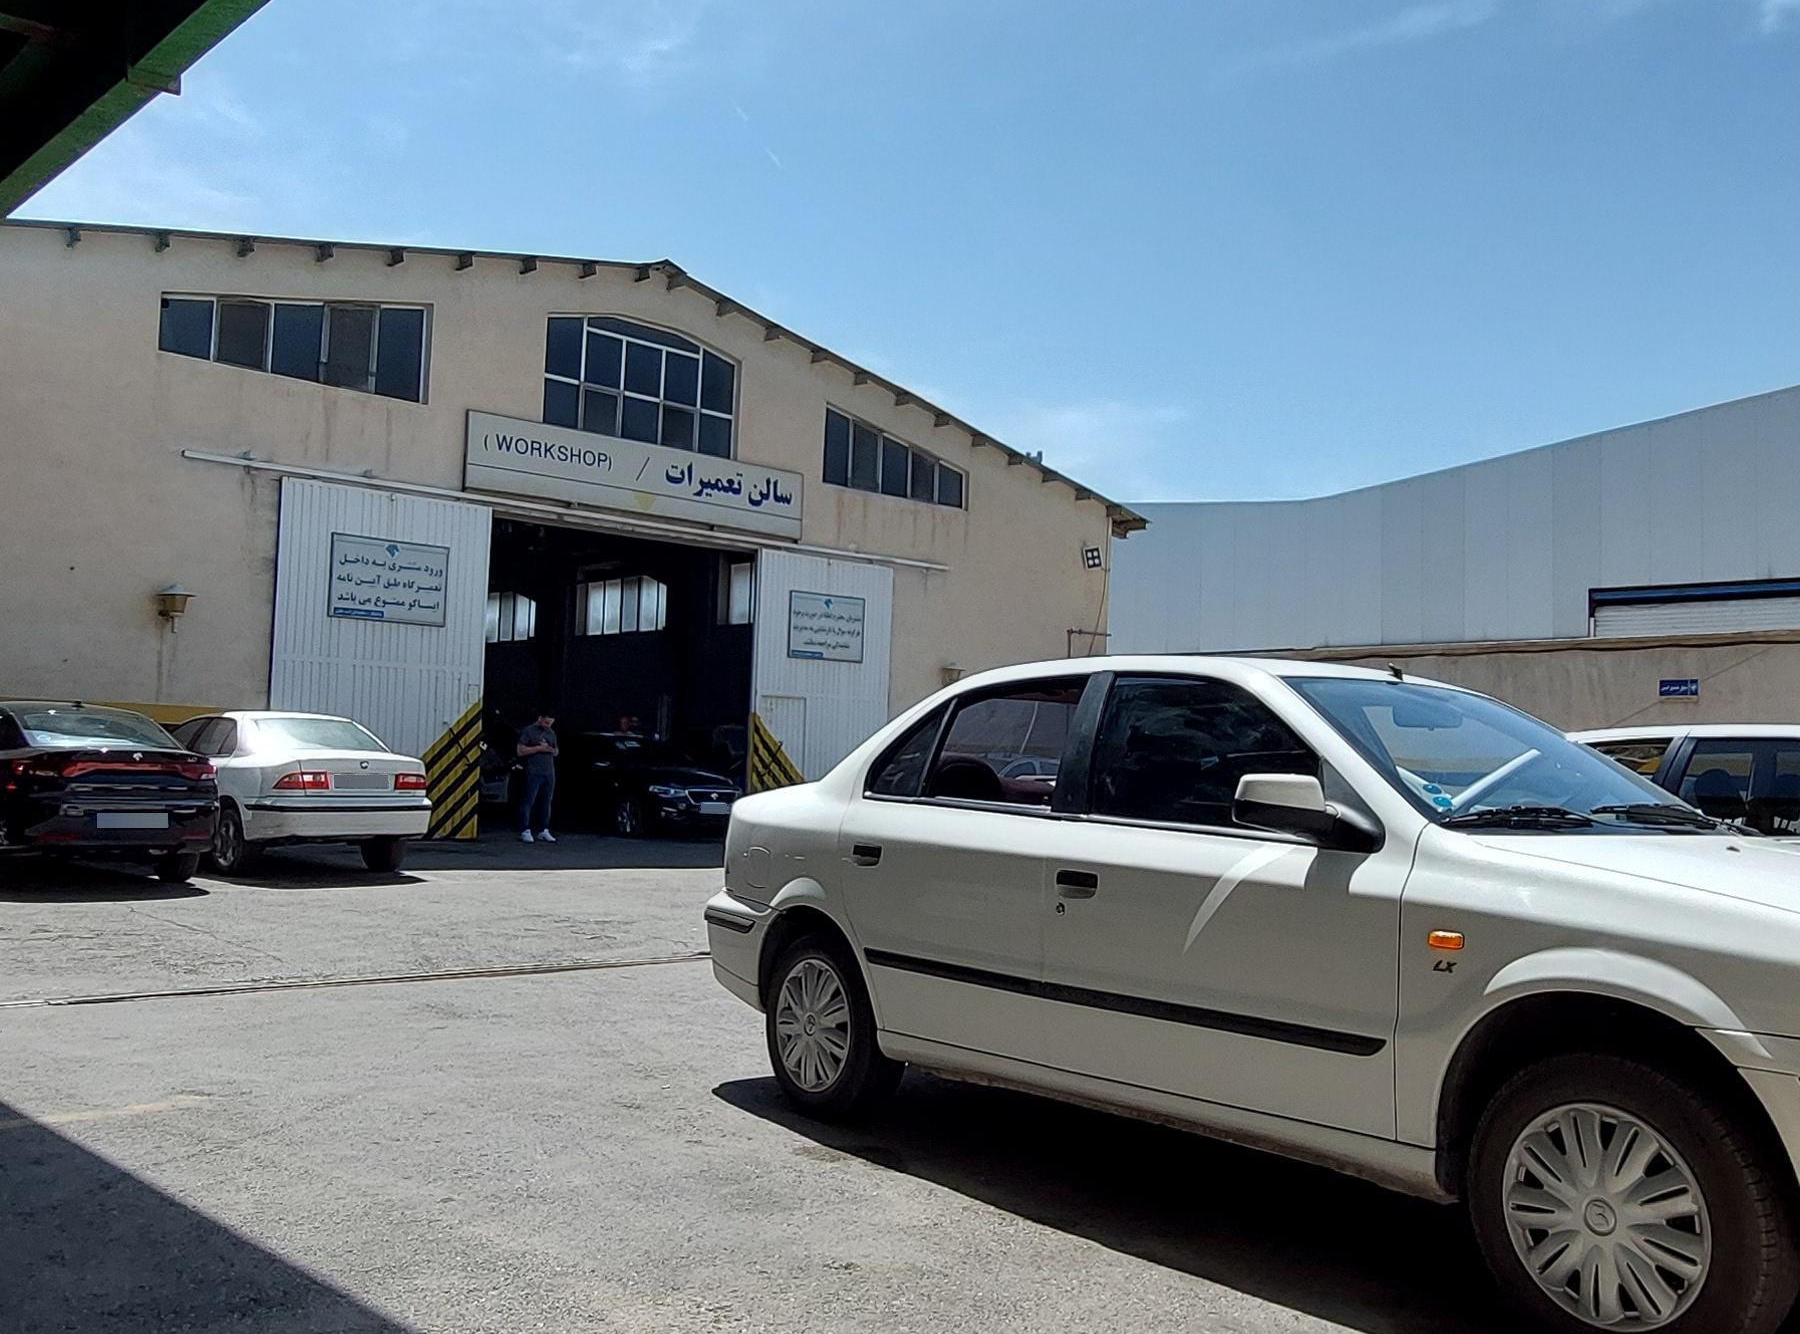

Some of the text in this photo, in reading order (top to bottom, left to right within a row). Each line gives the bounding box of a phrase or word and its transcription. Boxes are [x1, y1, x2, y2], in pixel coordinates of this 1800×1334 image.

[665, 461, 743, 497] تعمیرات
[748, 477, 793, 507] سالن
[339, 554, 370, 565] داخل
[424, 565, 443, 577] ورود
[1433, 960, 1458, 973] LX
